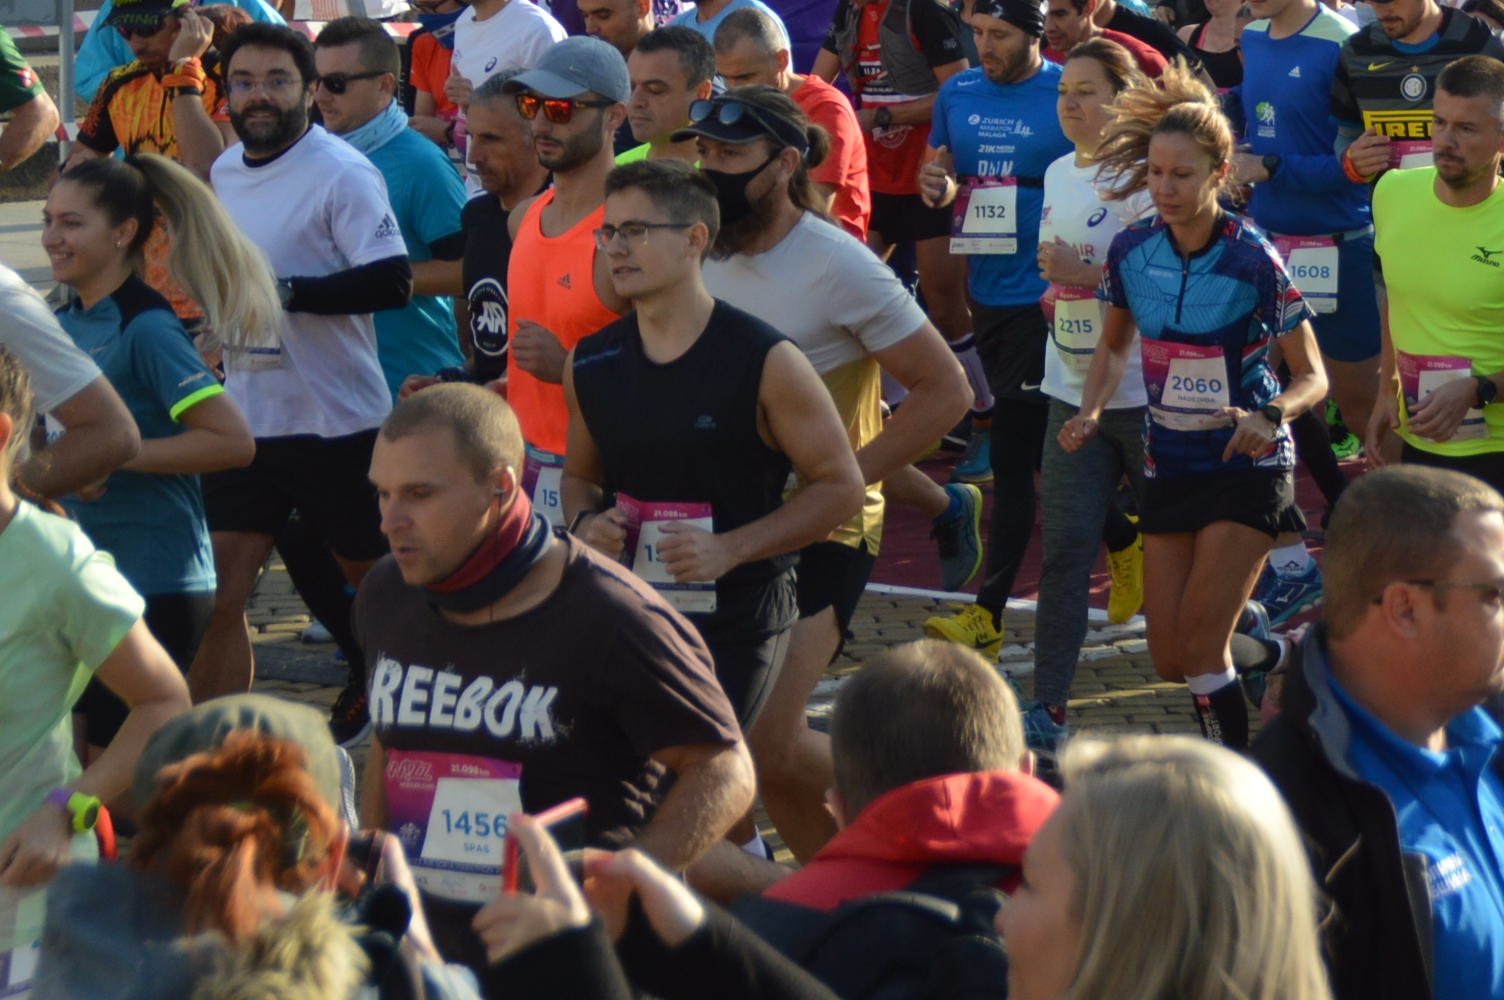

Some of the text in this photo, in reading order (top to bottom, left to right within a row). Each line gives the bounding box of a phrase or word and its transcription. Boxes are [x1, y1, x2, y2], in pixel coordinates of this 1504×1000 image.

[975, 205, 1005, 218] 1132
[1291, 265, 1330, 278] 1608
[1059, 317, 1093, 333] 2215
[1172, 375, 1222, 394] 2060
[369, 656, 558, 742] REEBOK
[441, 809, 509, 838] 1456
[463, 842, 490, 853] SPAS
